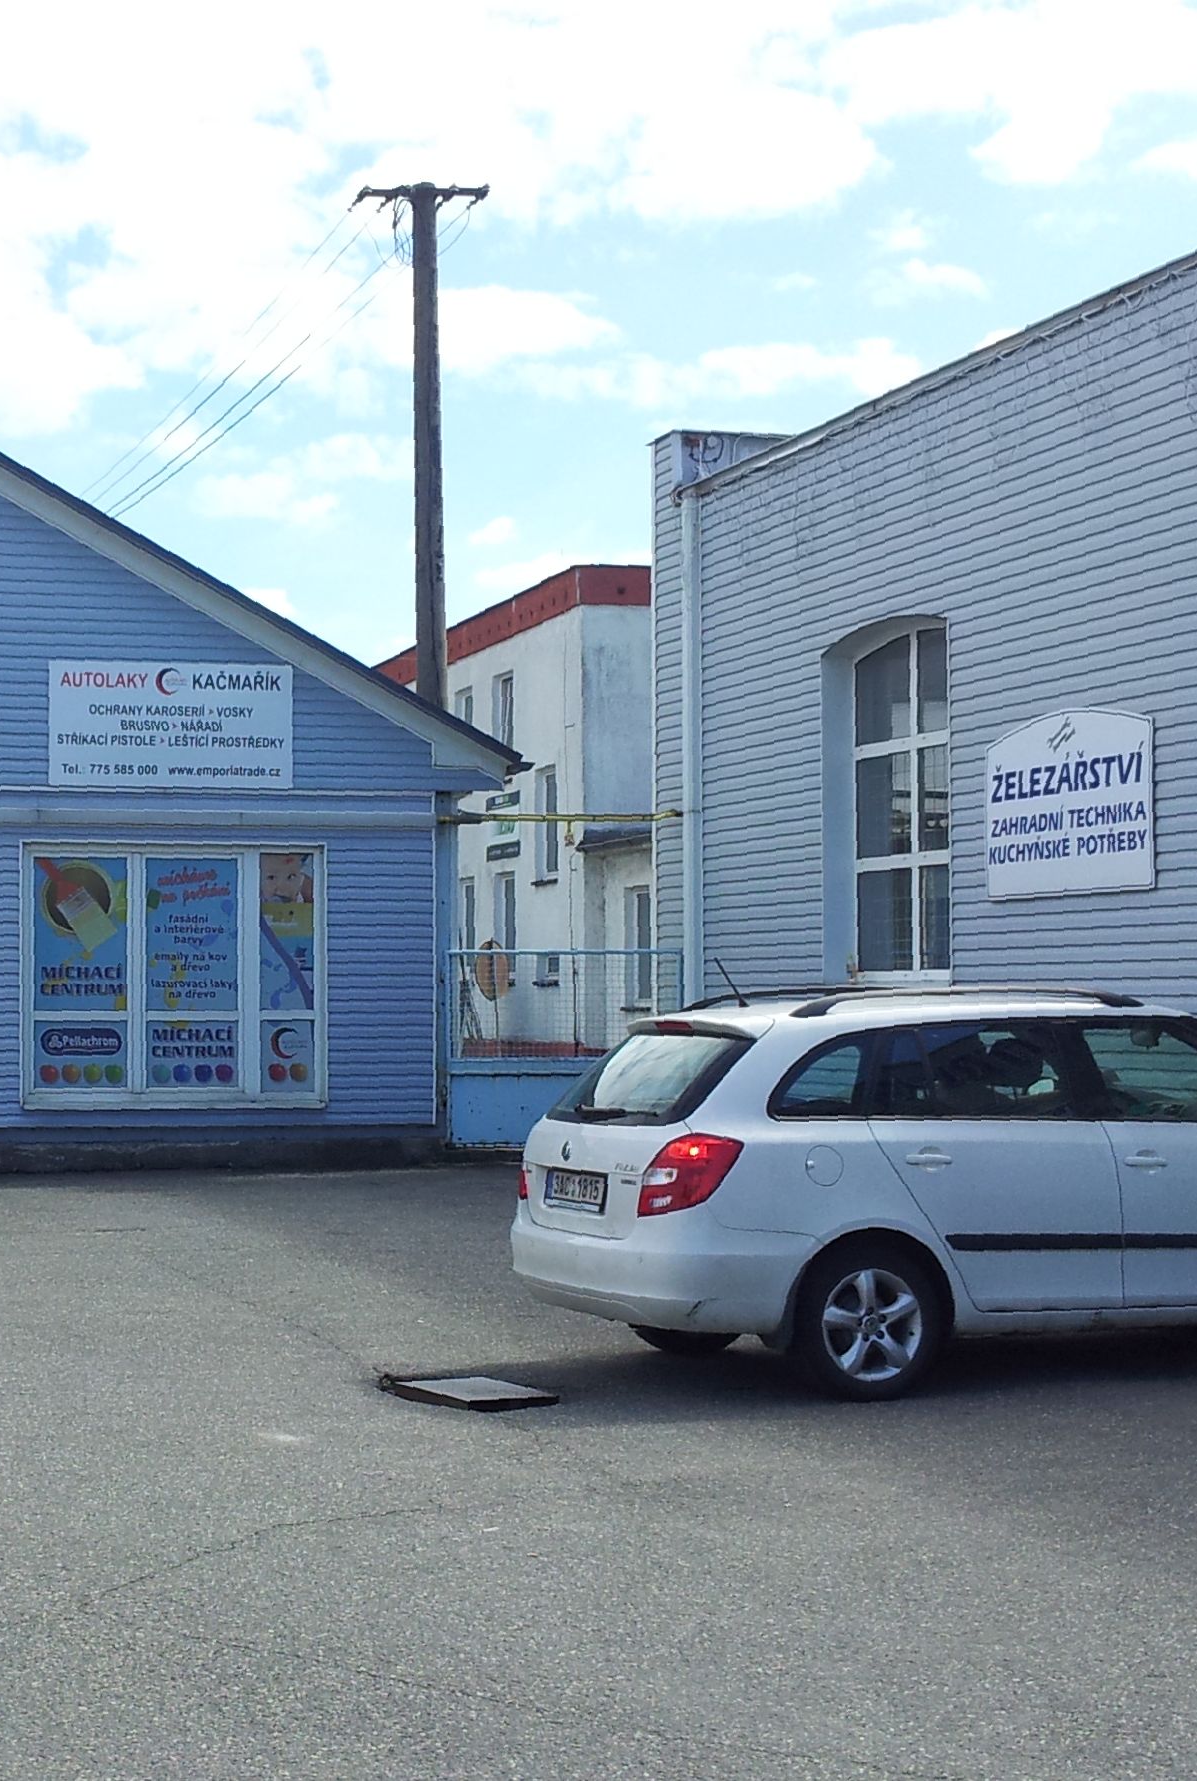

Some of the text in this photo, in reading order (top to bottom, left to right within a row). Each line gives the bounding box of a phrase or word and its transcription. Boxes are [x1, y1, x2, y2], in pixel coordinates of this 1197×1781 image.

[60, 672, 148, 689] AUTOLAKY
[192, 671, 281, 692] KAČMAŘÍK
[88, 704, 254, 718] OCHRANY KAROSERIÍ VOSKY
[120, 719, 223, 732] BRUSIVO NÁŘADÍ
[57, 732, 108, 746] STŘÍKACÍ
[110, 734, 156, 747] PISTOLE
[211, 735, 285, 749] PROSTŘEDKY
[89, 764, 110, 775] 775
[113, 764, 135, 775] 585
[137, 765, 158, 776] 000
[168, 765, 281, 778] www.emporiatrade.cz
[991, 741, 1145, 804] ŽELEZÁŘSTVÍ
[991, 800, 1147, 838] ZAHRADNÍ TECHNIKA
[988, 828, 1147, 866] KUCHYŇSKÉ POTŘEBY
[154, 926, 161, 934] a
[173, 936, 204, 946] barvy
[192, 953, 205, 962] na
[208, 952, 228, 961] kov
[41, 962, 122, 979] MÍCHACÍ
[40, 983, 126, 997] CENTRUM
[168, 990, 182, 999] na
[151, 1026, 233, 1042] MÍCHACÍ
[151, 1045, 235, 1058] CENTRUM
[577, 1174, 600, 1201] 1815
